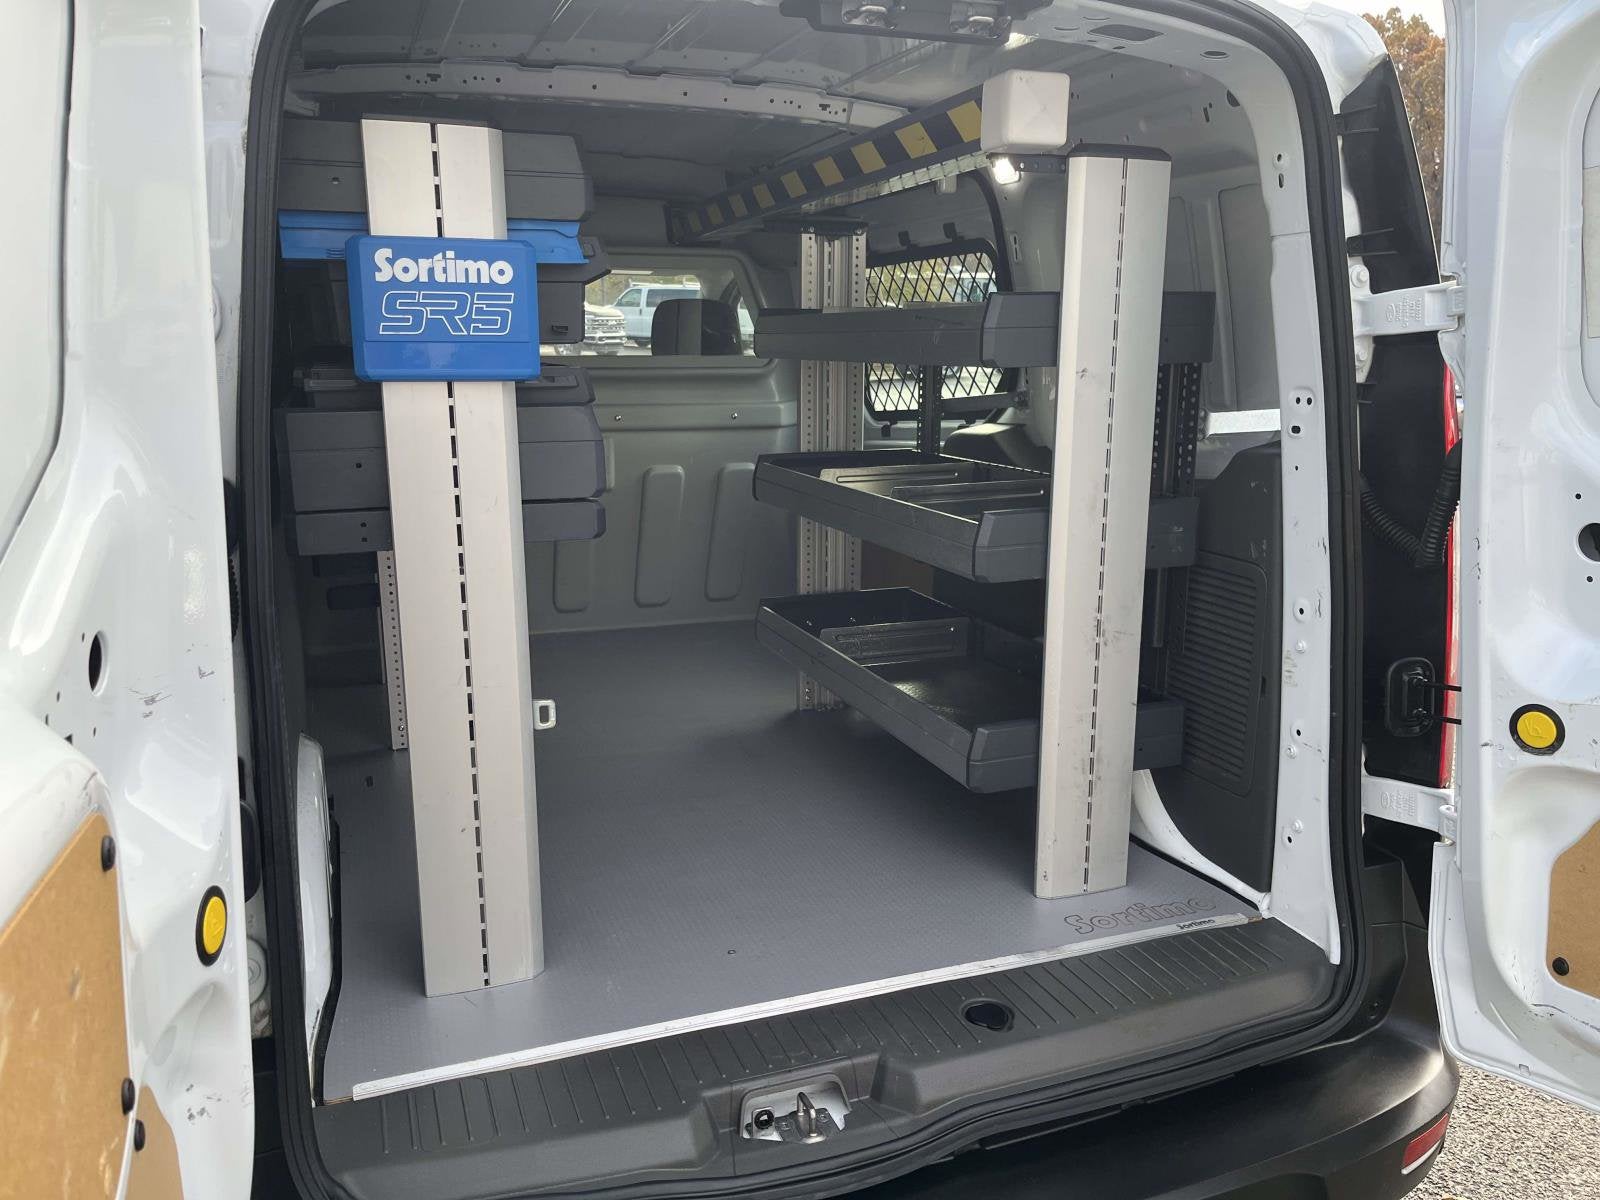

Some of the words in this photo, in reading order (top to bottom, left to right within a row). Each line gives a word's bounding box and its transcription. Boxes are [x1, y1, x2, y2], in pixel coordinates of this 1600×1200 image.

[374, 248, 513, 284] Sortimo
[379, 291, 514, 335] SR5
[1064, 898, 1216, 934] Sortimo
[1176, 919, 1215, 929] Sortimo
